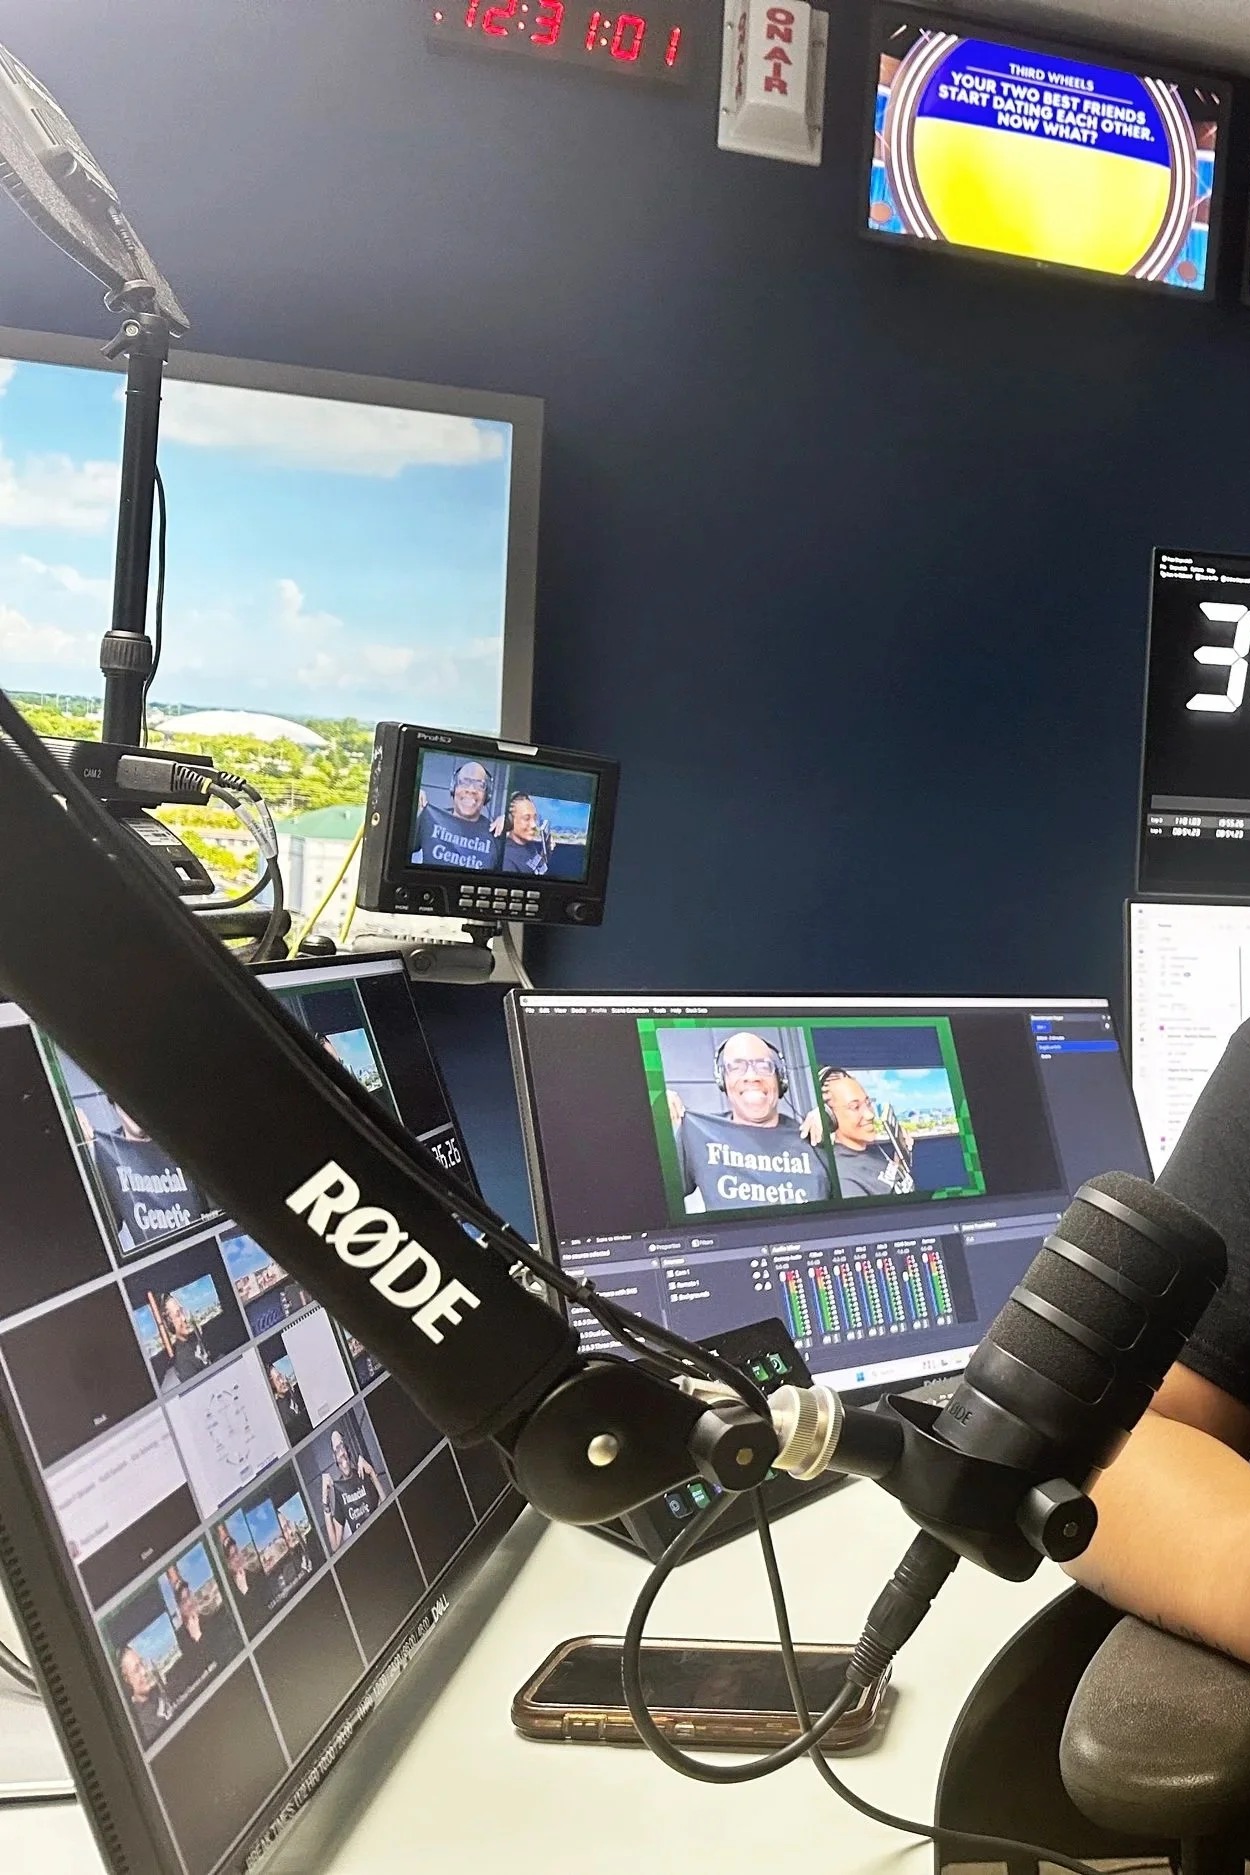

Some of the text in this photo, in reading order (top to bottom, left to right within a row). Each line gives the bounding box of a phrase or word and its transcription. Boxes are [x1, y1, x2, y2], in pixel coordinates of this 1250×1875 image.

[763, 7, 795, 96] ON AIR
[1009, 63, 1095, 92] THIRD WHEELS
[951, 71, 1146, 125] YOUR TWO BEST FRIENDS
[938, 85, 1155, 142] START DATING EACH OTHER.
[997, 111, 1099, 144] NOW WHAT?
[84, 768, 96, 778] CAM
[431, 824, 492, 853] Financial
[432, 844, 484, 869] Genetic
[705, 1142, 812, 1175] Financial
[116, 1165, 188, 1193] Financial
[717, 1174, 809, 1204] Genetic
[133, 1202, 191, 1230] Genetic
[285, 1160, 480, 1344] RØDE
[431, 1593, 450, 1623] DELL
